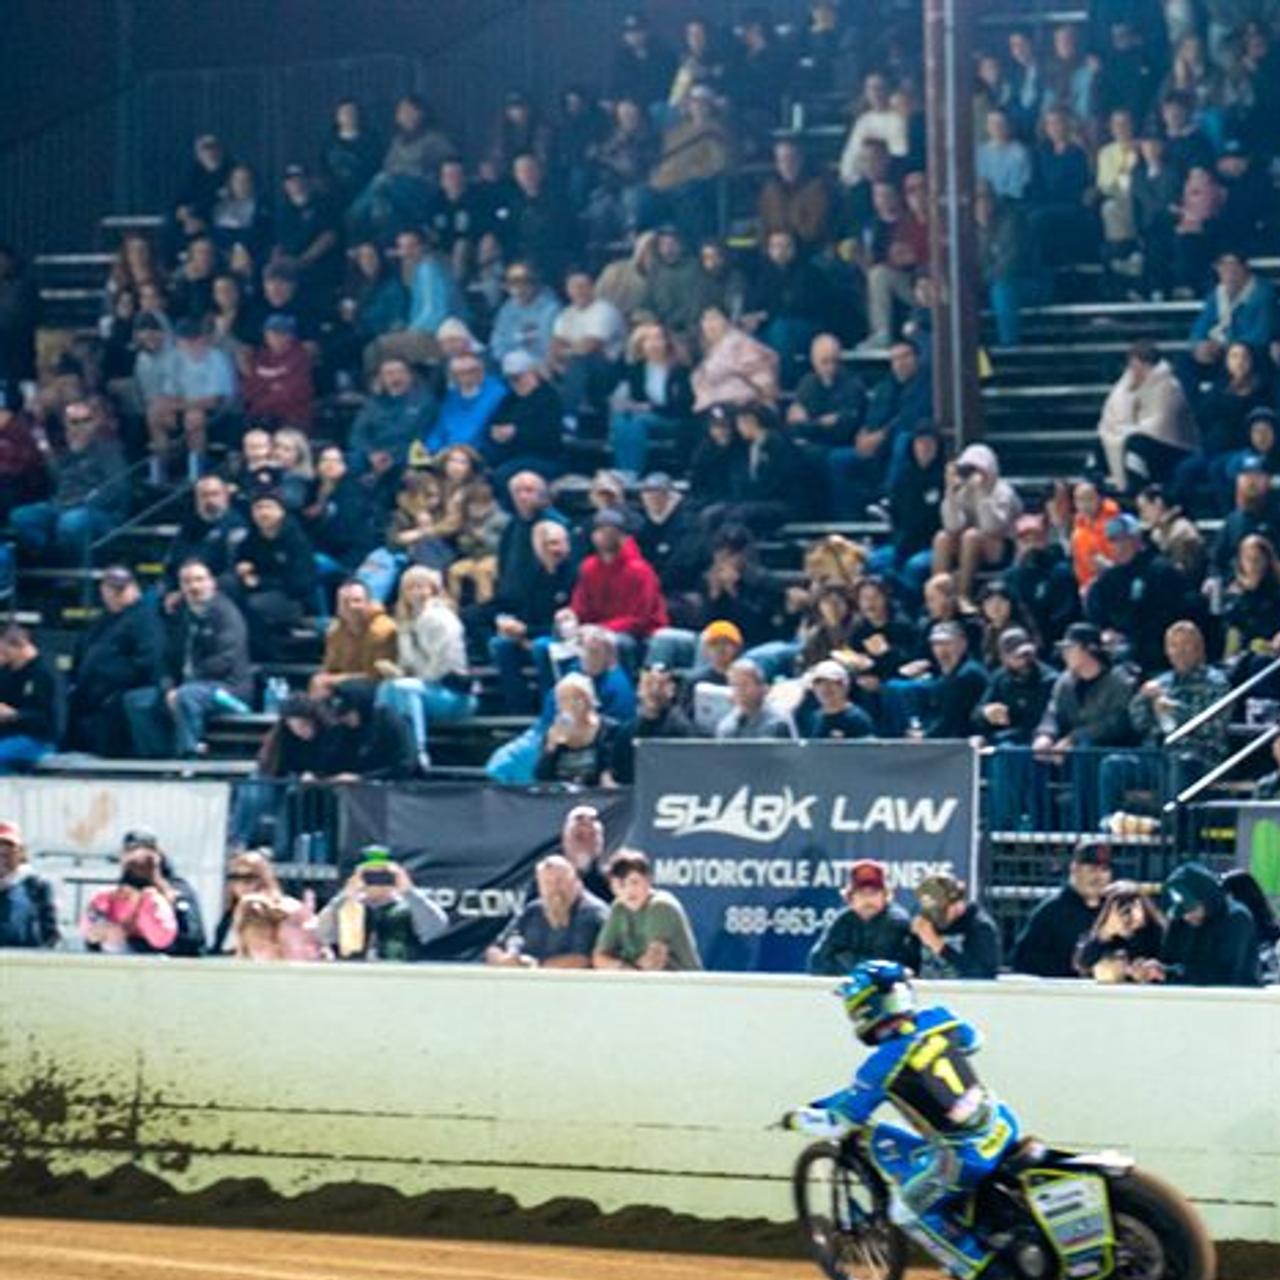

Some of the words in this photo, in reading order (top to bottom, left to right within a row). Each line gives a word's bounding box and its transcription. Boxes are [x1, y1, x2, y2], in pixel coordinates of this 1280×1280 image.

[654, 786, 817, 842] SHARK
[831, 796, 958, 833] LAW
[655, 858, 811, 887] MOTORCYCLE
[812, 860, 956, 887] ATTNEYS
